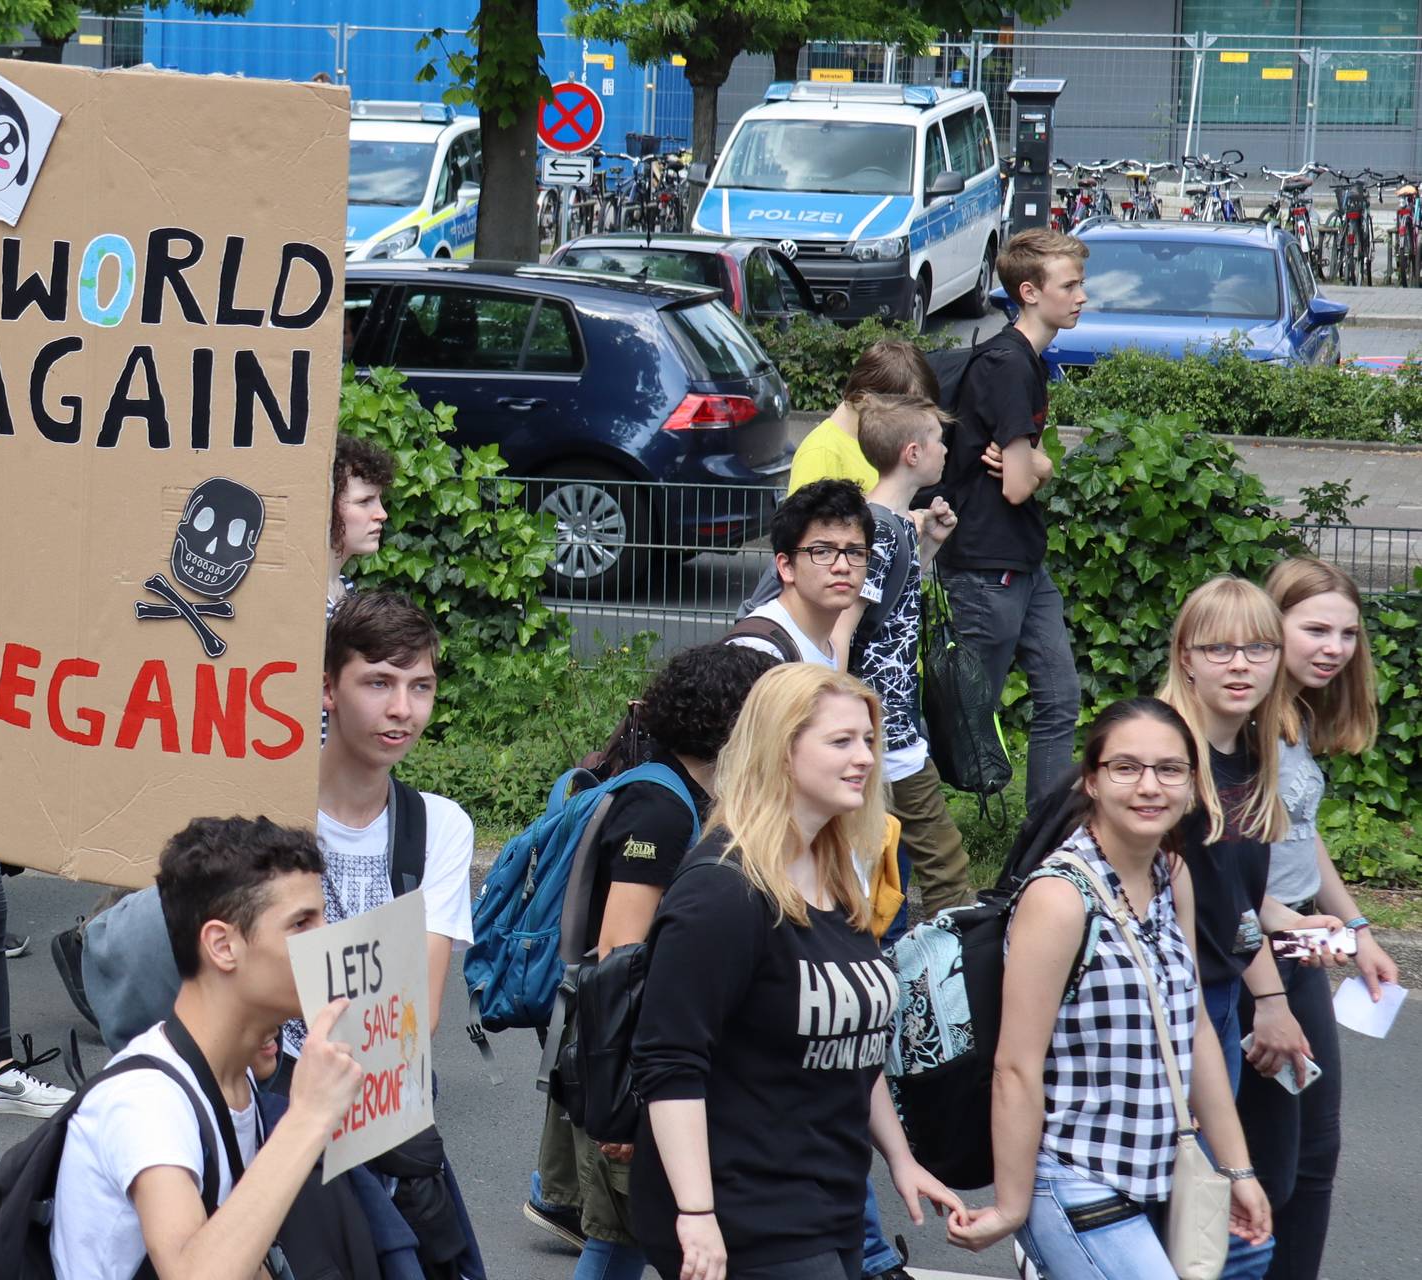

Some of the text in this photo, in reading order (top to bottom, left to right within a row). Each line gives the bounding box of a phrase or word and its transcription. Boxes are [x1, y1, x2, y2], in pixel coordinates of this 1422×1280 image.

[747, 209, 844, 224] POLIZEI
[0, 227, 334, 329] WORLD
[326, 940, 383, 1004] LETS
[797, 959, 861, 1036] HA
[362, 995, 399, 1051] SAVE
[802, 1036, 857, 1070] HOW
